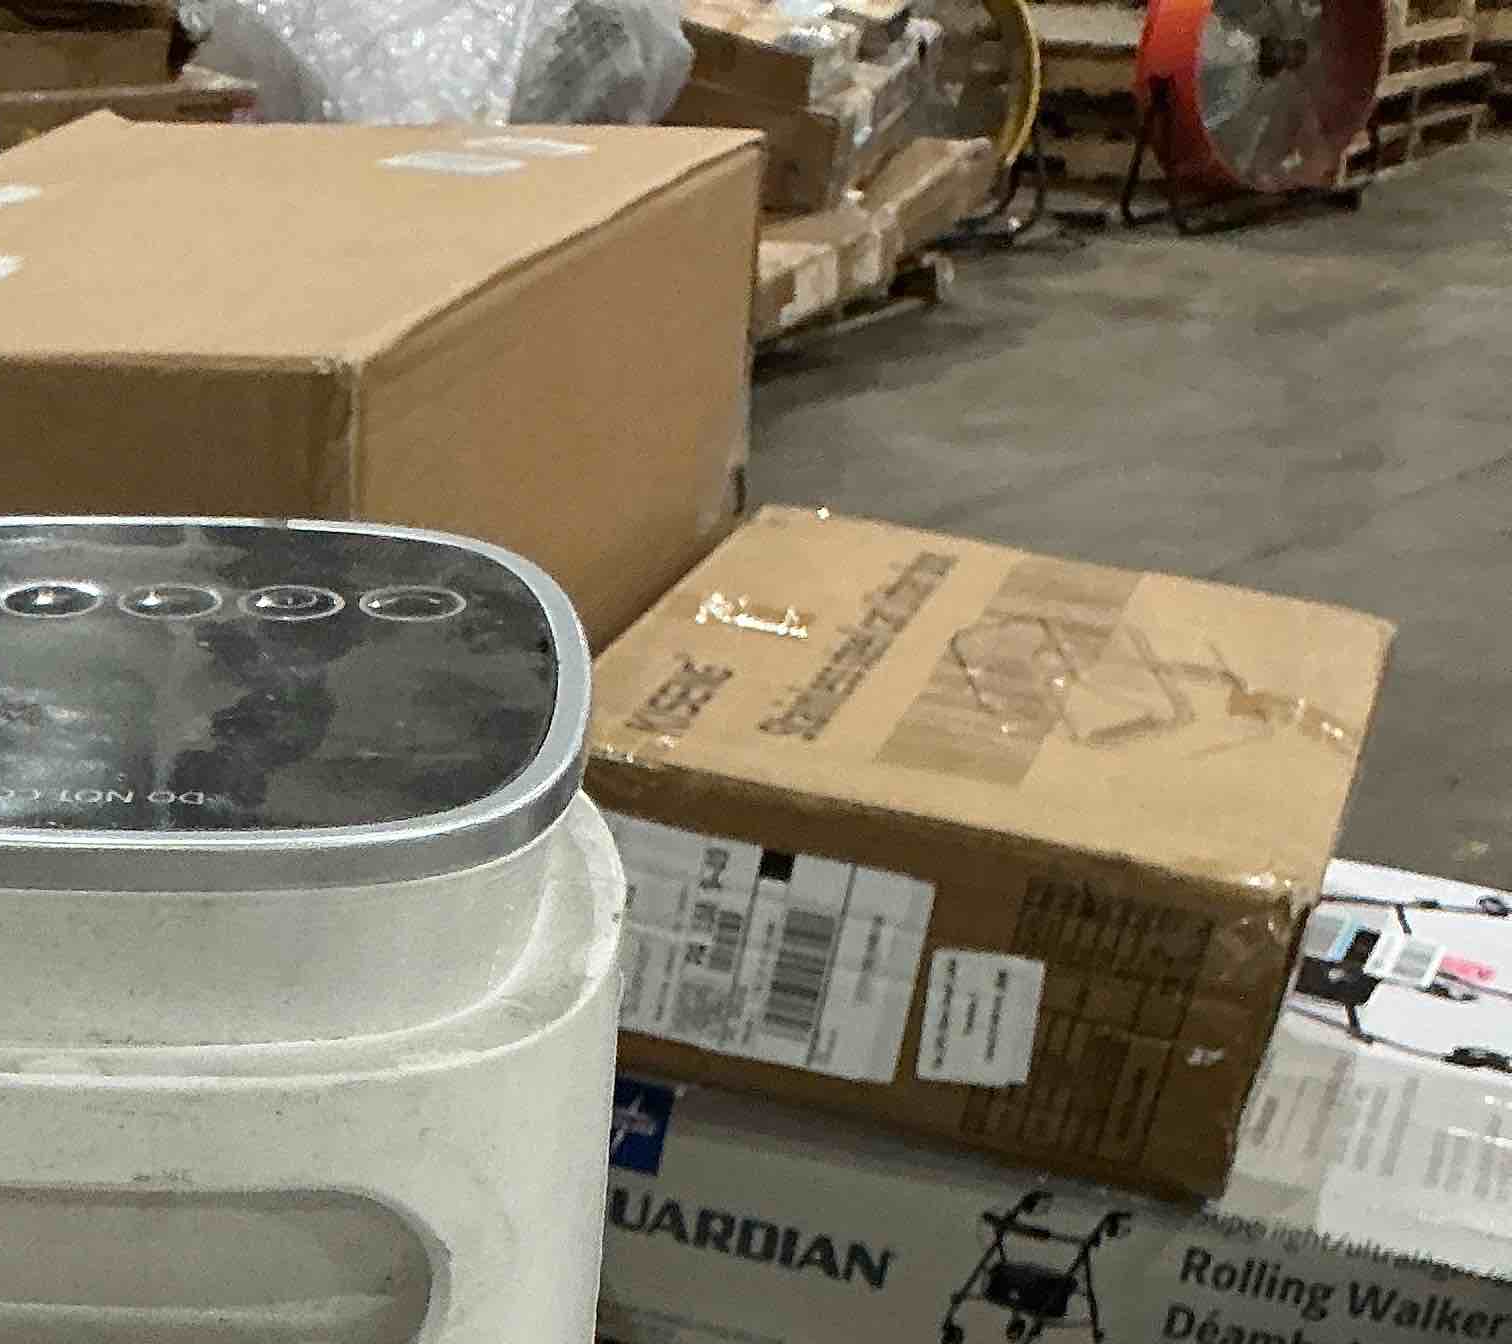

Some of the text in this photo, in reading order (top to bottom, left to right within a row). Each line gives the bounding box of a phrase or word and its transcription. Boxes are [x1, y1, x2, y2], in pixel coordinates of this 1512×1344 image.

[58, 788, 136, 804] NOT
[146, 790, 205, 805] DO
[607, 1187, 893, 1290] UARDIAN
[1179, 1246, 1512, 1340] Rolling Walker
